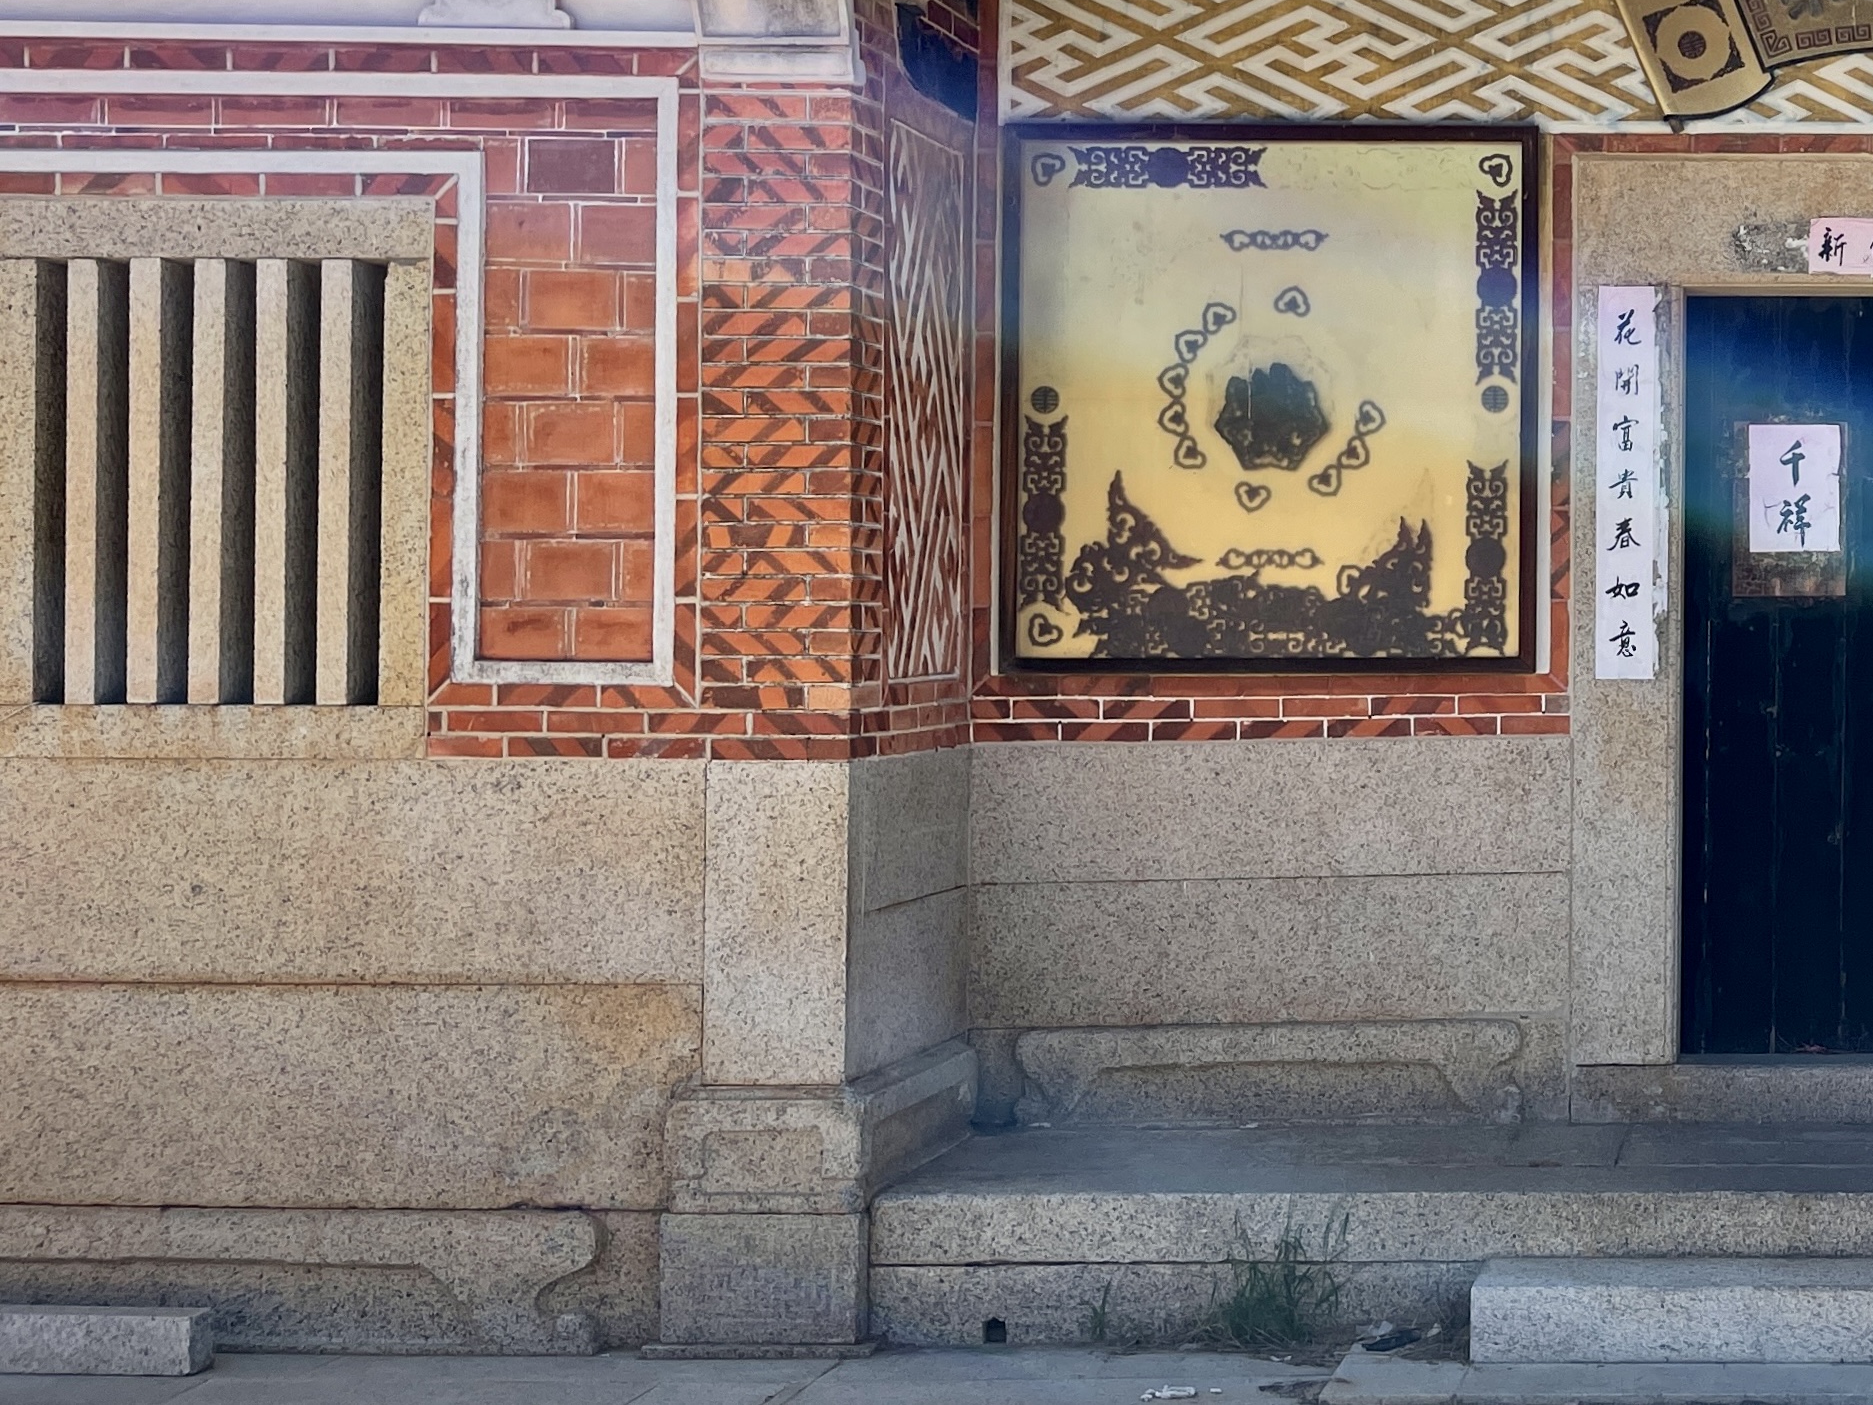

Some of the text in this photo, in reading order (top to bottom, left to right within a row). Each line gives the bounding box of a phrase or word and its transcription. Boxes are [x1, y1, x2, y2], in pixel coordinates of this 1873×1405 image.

[1605, 310, 1642, 659] 花開富貴春如意
[1776, 440, 1812, 547] 千祥
